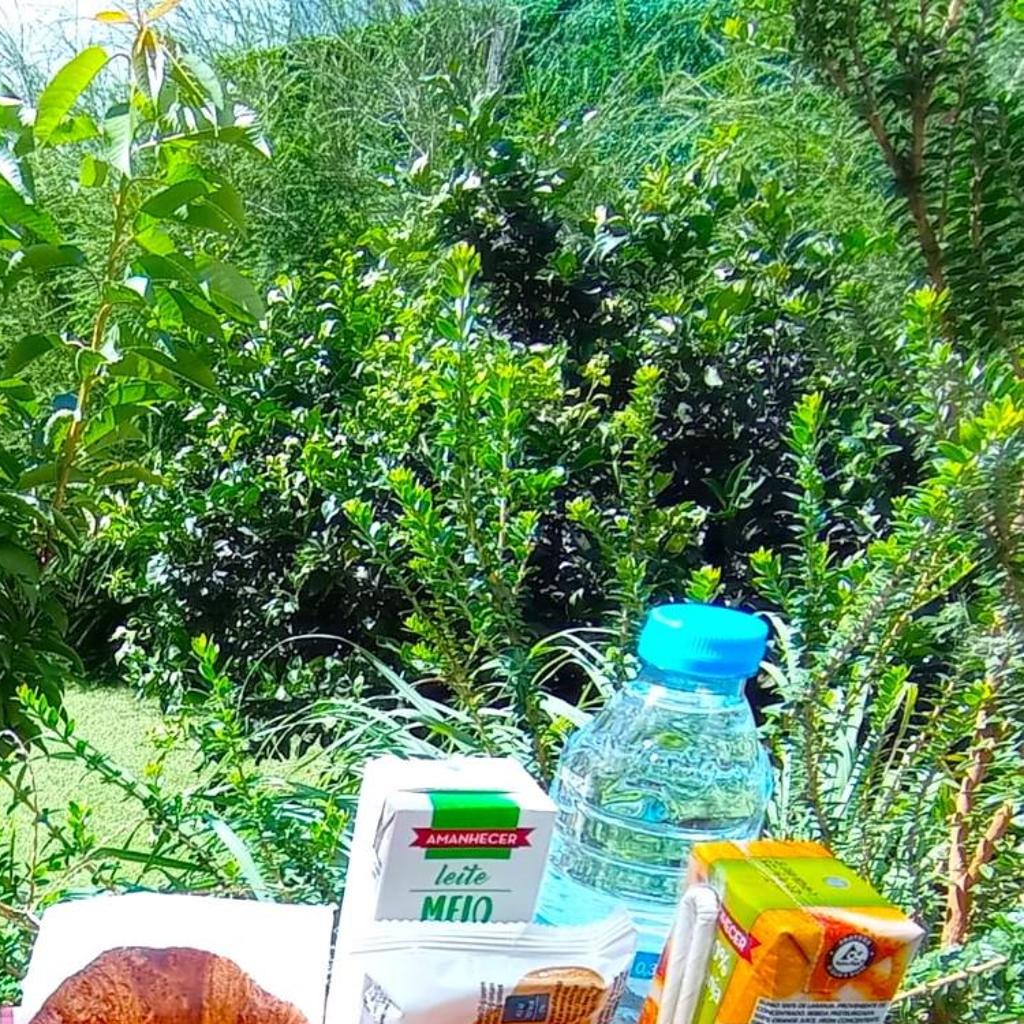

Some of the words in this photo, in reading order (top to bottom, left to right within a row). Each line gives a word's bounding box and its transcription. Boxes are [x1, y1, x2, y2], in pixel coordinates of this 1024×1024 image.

[426, 833, 518, 846] AMANHECER
[434, 864, 492, 887] leite
[419, 895, 494, 923] MEIO
